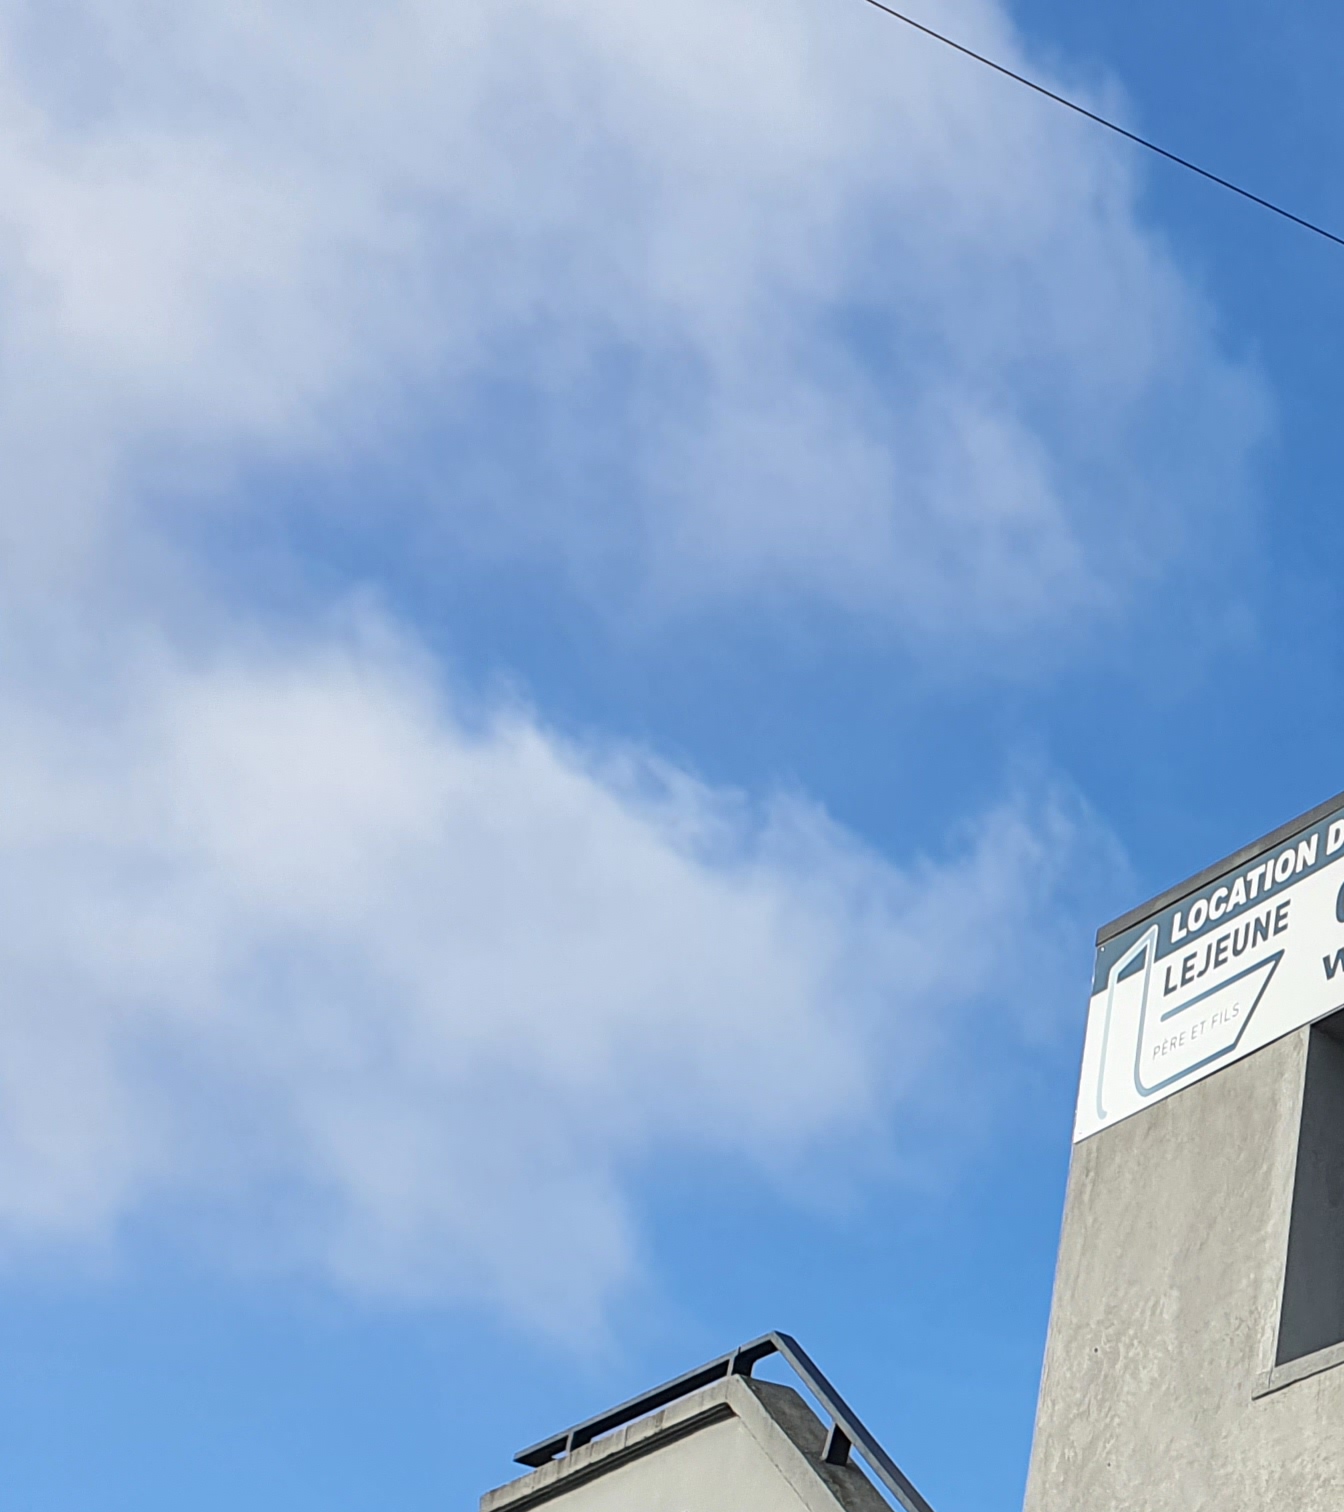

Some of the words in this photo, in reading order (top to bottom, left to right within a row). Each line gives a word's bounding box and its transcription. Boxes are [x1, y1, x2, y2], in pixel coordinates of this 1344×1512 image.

[1170, 833, 1319, 944] LOCATION
[1163, 899, 1291, 997] LEJEUNE
[1152, 1031, 1186, 1061] PÈRE
[1191, 1019, 1206, 1041] ET
[1211, 1002, 1240, 1027] FILS
